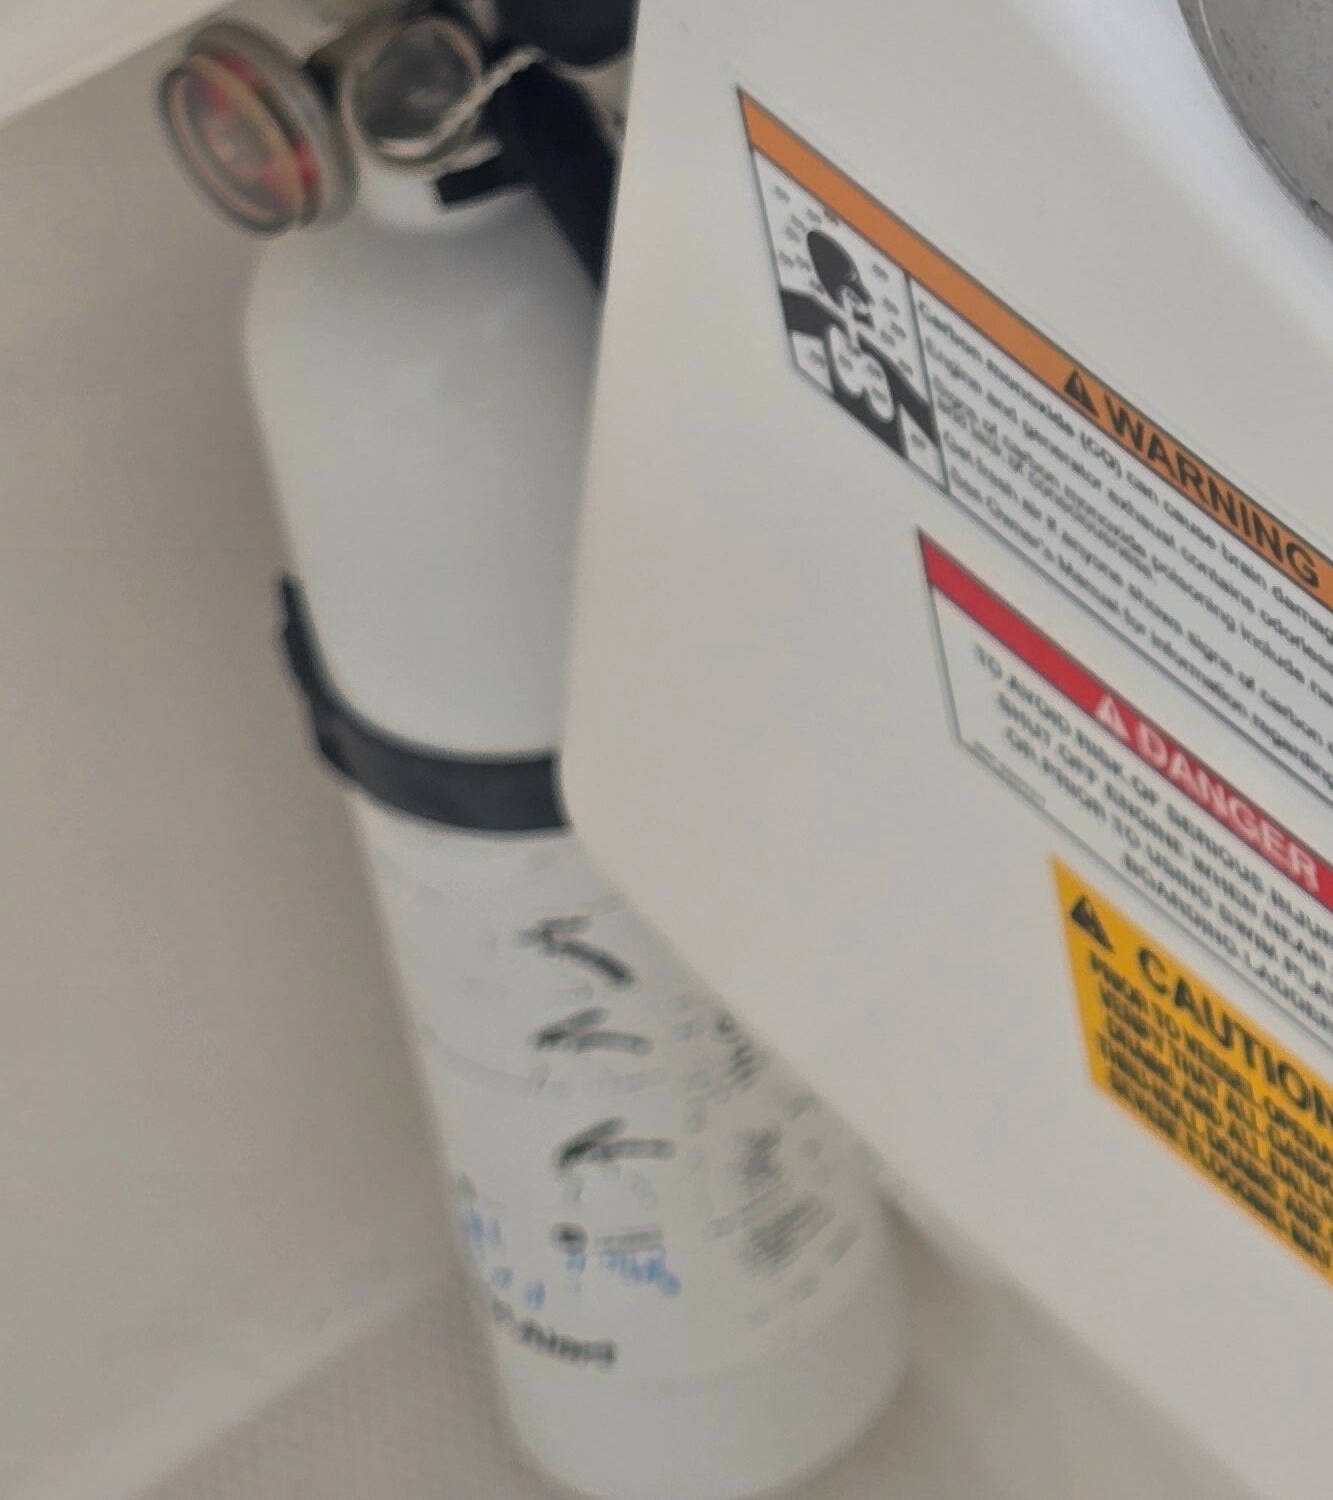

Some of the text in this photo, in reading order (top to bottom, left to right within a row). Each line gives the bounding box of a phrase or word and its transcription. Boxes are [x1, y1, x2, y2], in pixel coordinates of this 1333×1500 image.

[1101, 390, 1321, 593] WARNING
[1162, 496, 1216, 551] cause
[1220, 539, 1266, 591] brain
[1179, 541, 1256, 615] contains
[973, 640, 1005, 684] TO
[1006, 668, 1072, 740] AVOID
[1128, 768, 1160, 812] OF
[1187, 627, 1235, 683] signs
[1236, 664, 1257, 695] of
[1259, 683, 1324, 749] carbon
[1239, 619, 1306, 687] include
[994, 687, 1054, 753] SHUT
[1055, 738, 1101, 791] OFF
[1262, 906, 1327, 977] NEAR
[1039, 752, 1109, 826] PRIOR
[1112, 812, 1143, 854] TO
[1145, 840, 1214, 913] USING
[1216, 897, 1279, 965] SWIM
[1130, 711, 1322, 900] DANGER
[1121, 848, 1240, 962] BOARDING
